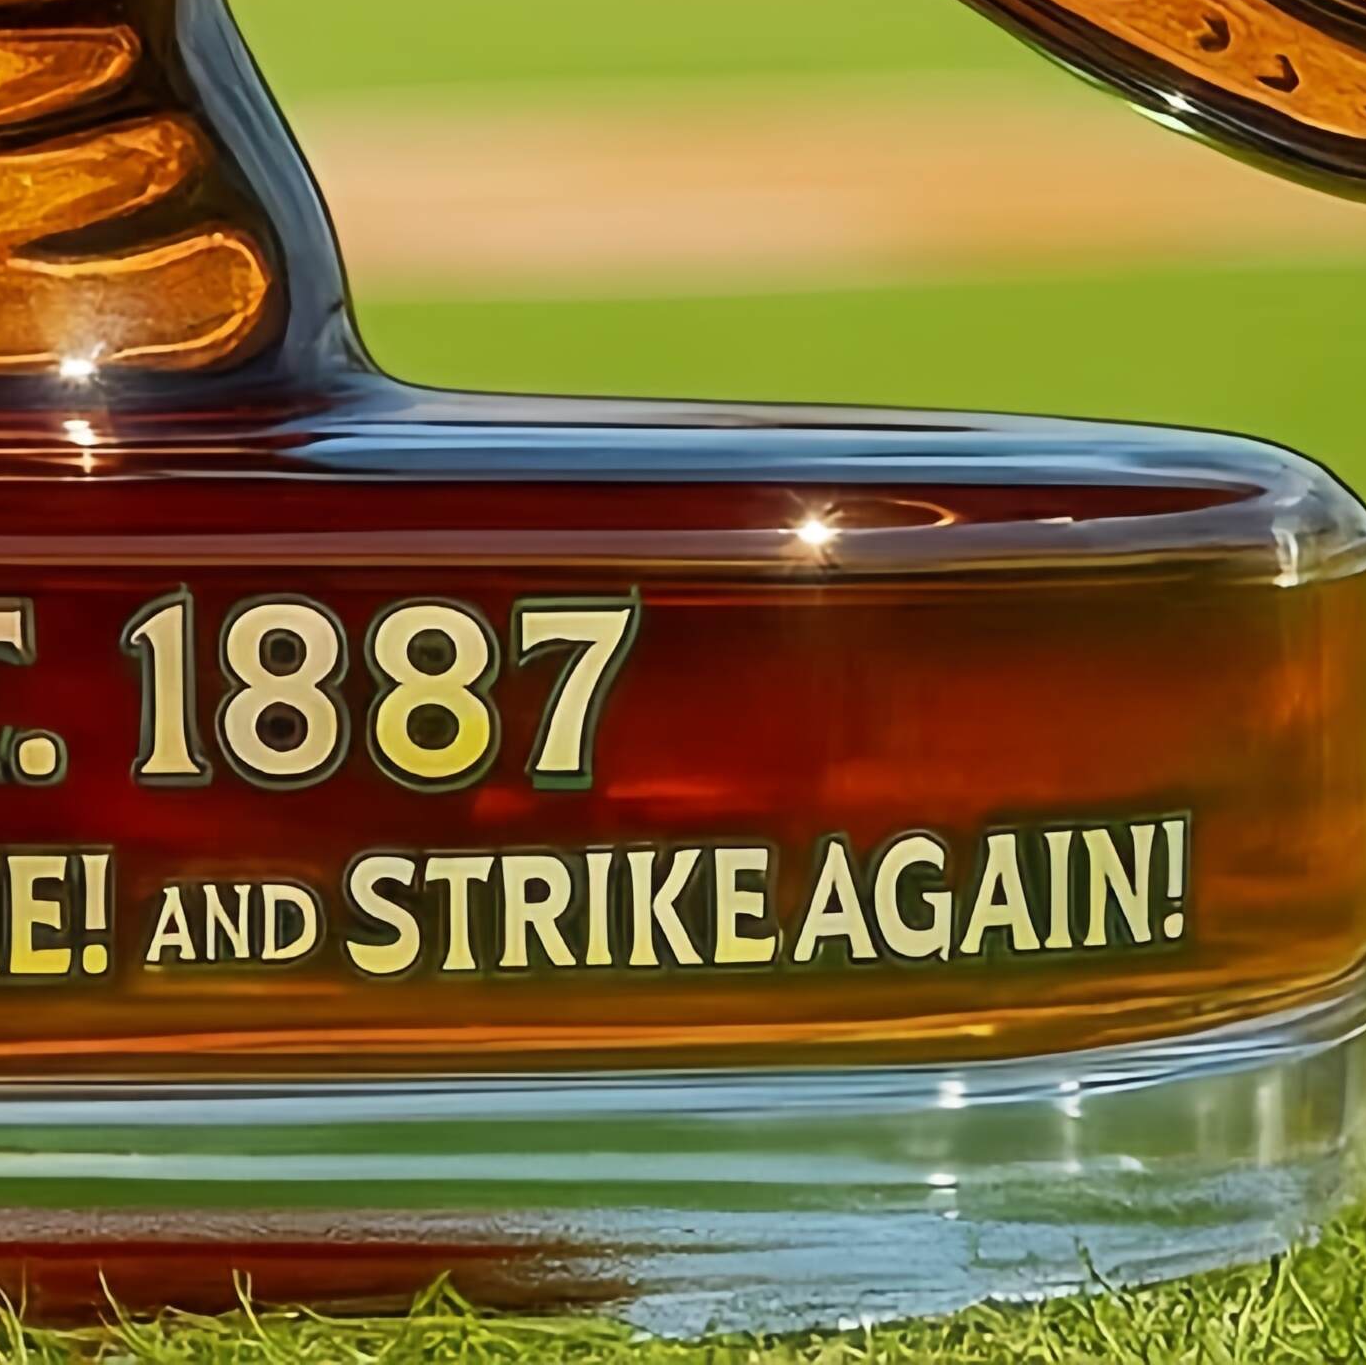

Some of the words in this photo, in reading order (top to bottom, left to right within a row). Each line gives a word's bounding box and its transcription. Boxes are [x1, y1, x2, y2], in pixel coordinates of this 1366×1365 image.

[129, 602, 633, 780] 1887
[144, 882, 319, 963] AND
[346, 842, 778, 975] STRIKE
[792, 819, 1187, 966] AGAIN!
